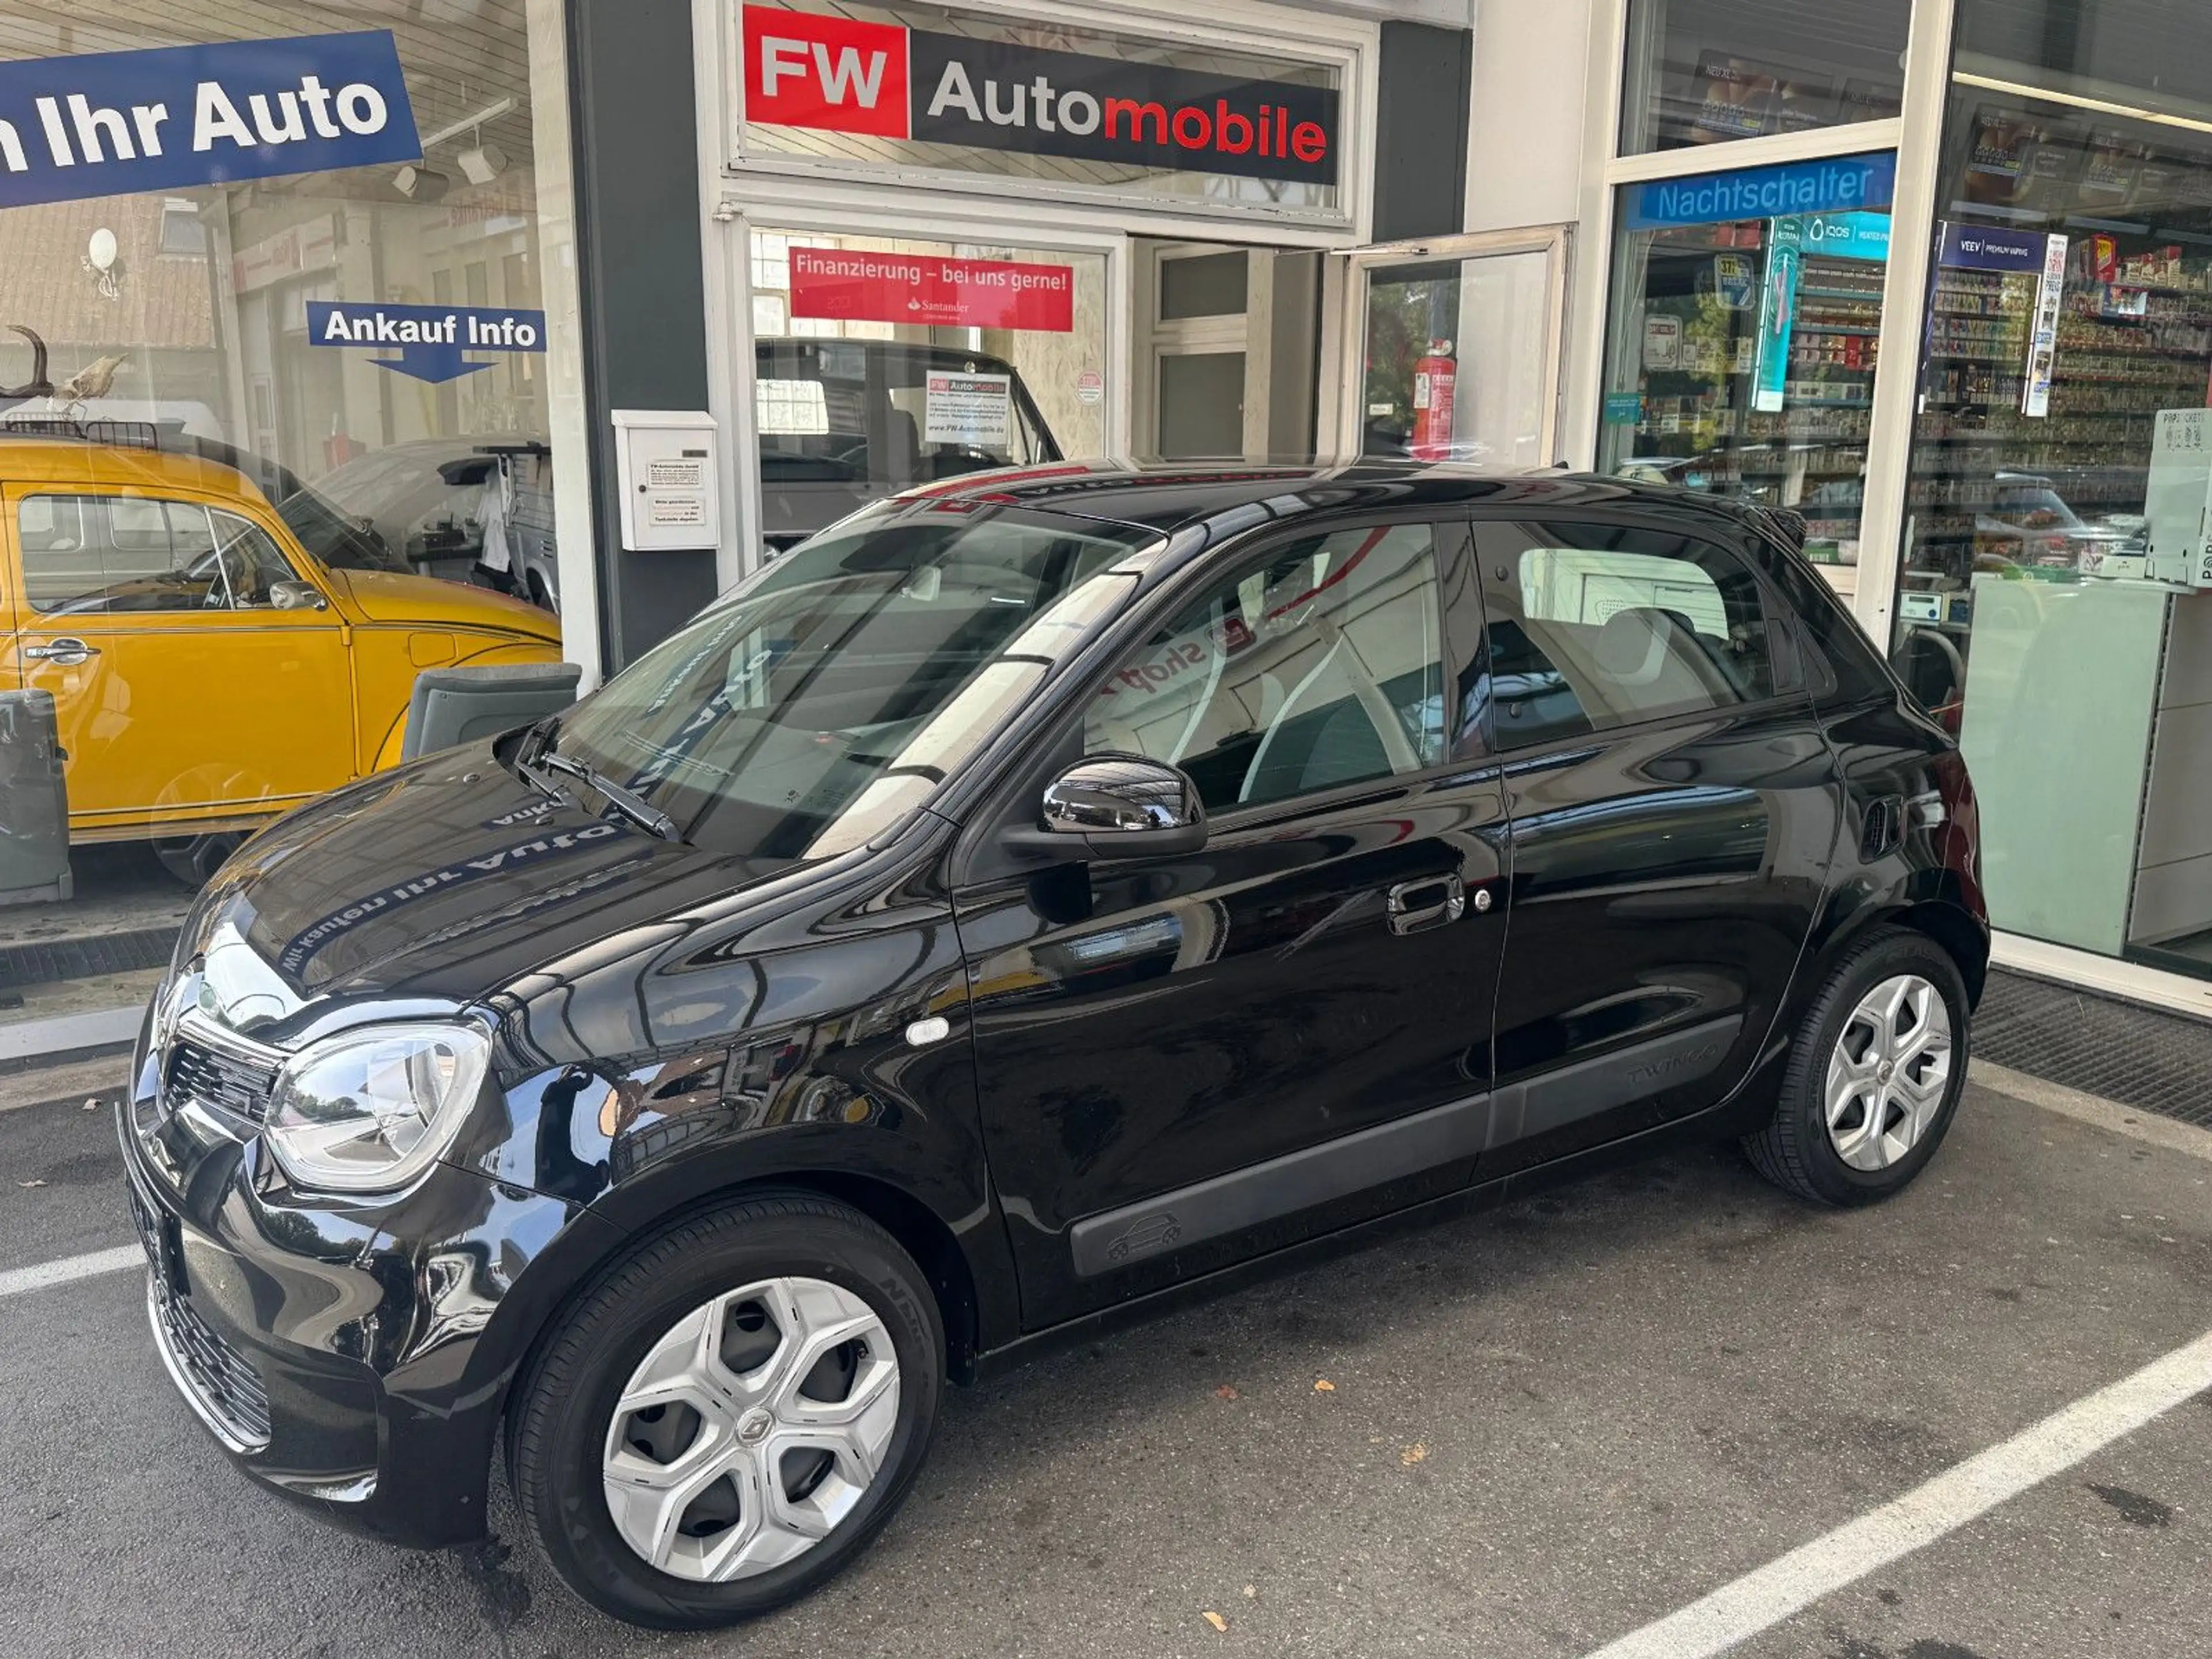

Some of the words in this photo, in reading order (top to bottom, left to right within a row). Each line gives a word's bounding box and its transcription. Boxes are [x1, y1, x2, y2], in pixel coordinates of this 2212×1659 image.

[762, 36, 887, 108] FW
[928, 61, 1327, 162] Automobile
[36, 94, 169, 166] Ihr
[194, 76, 387, 151] Auto
[1658, 166, 1873, 219] Nachtschalter
[1961, 240, 1981, 252] VEEV
[797, 254, 920, 285] Finanzierung
[943, 264, 969, 284] bei
[976, 272, 1006, 286] uns
[1011, 274, 1066, 292] gerne!
[922, 300, 969, 313] Santander
[325, 311, 456, 343] Ankauf
[468, 316, 536, 346] Info
